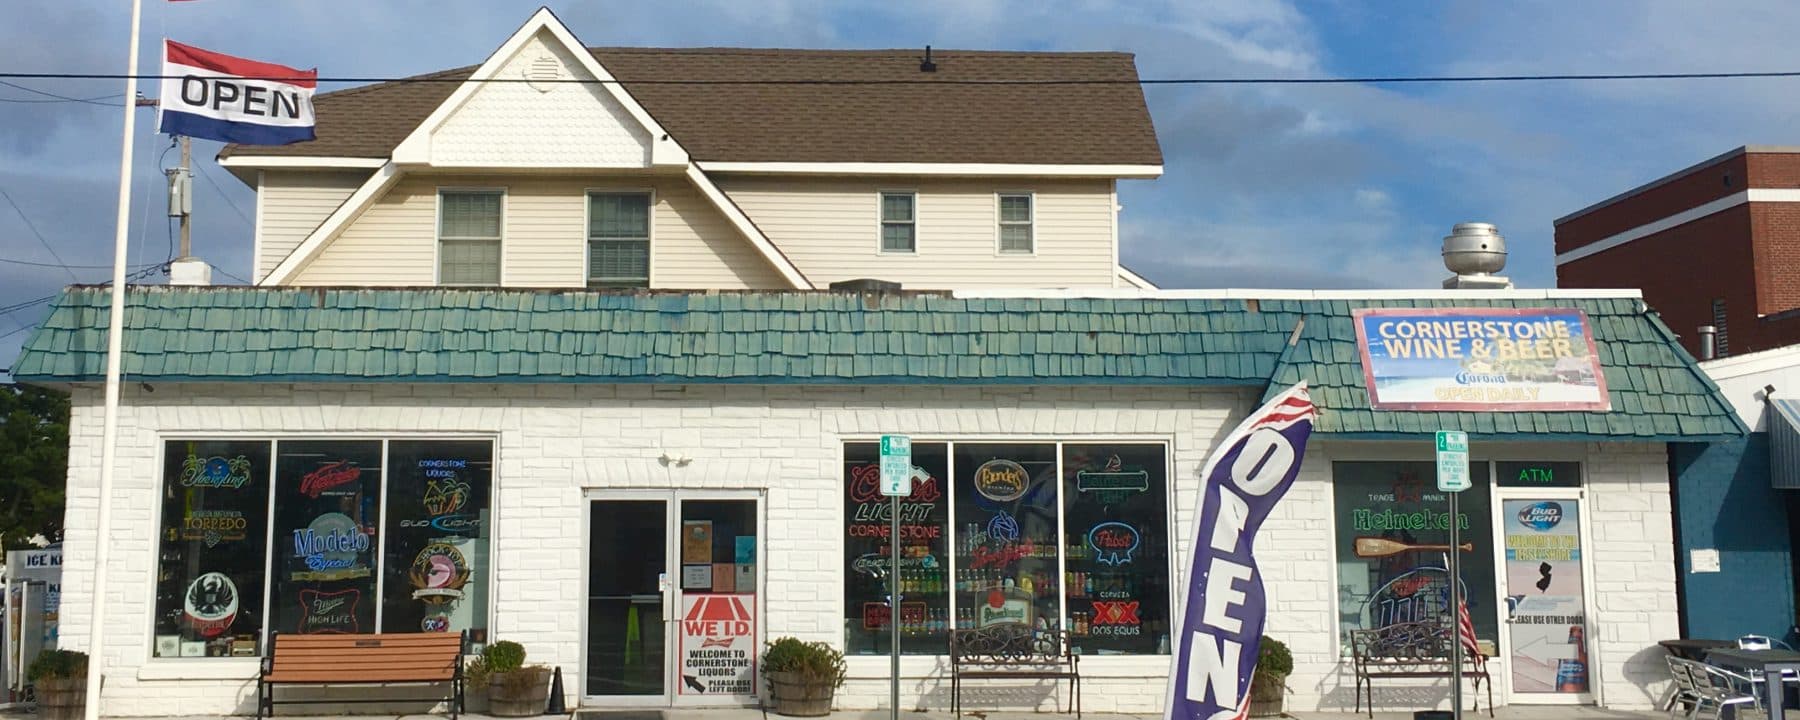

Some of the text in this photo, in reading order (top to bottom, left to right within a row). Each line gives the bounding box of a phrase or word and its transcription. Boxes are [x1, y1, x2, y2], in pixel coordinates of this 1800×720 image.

[181, 74, 300, 119] OPEN
[1378, 320, 1570, 339] CORNERSTONE
[1382, 338, 1574, 360] WINE & BEER
[1455, 371, 1506, 385] Corona
[1434, 386, 1541, 400] OPEN DAILY
[1519, 469, 1553, 482] ATM
[1368, 494, 1395, 502] TRADE
[1531, 507, 1558, 515] BUD
[184, 517, 247, 530] TORPEDO
[1353, 508, 1470, 531] Heineken
[849, 524, 942, 538] CORNESTONE
[293, 527, 371, 558] Modelo
[27, 554, 47, 566] ICE
[1186, 426, 1295, 712] OPEN
[308, 614, 350, 625] HIGH LIFE
[1092, 602, 1140, 624] XX
[1533, 615, 1545, 624] USE
[1545, 615, 1565, 625] OTHER
[685, 621, 752, 636] WE I.D.
[1092, 625, 1141, 635] DOS EQUIS
[690, 650, 746, 658] WELCOME TO
[686, 659, 748, 668] CORNERSTONE
[698, 668, 736, 677] LIQUORS
